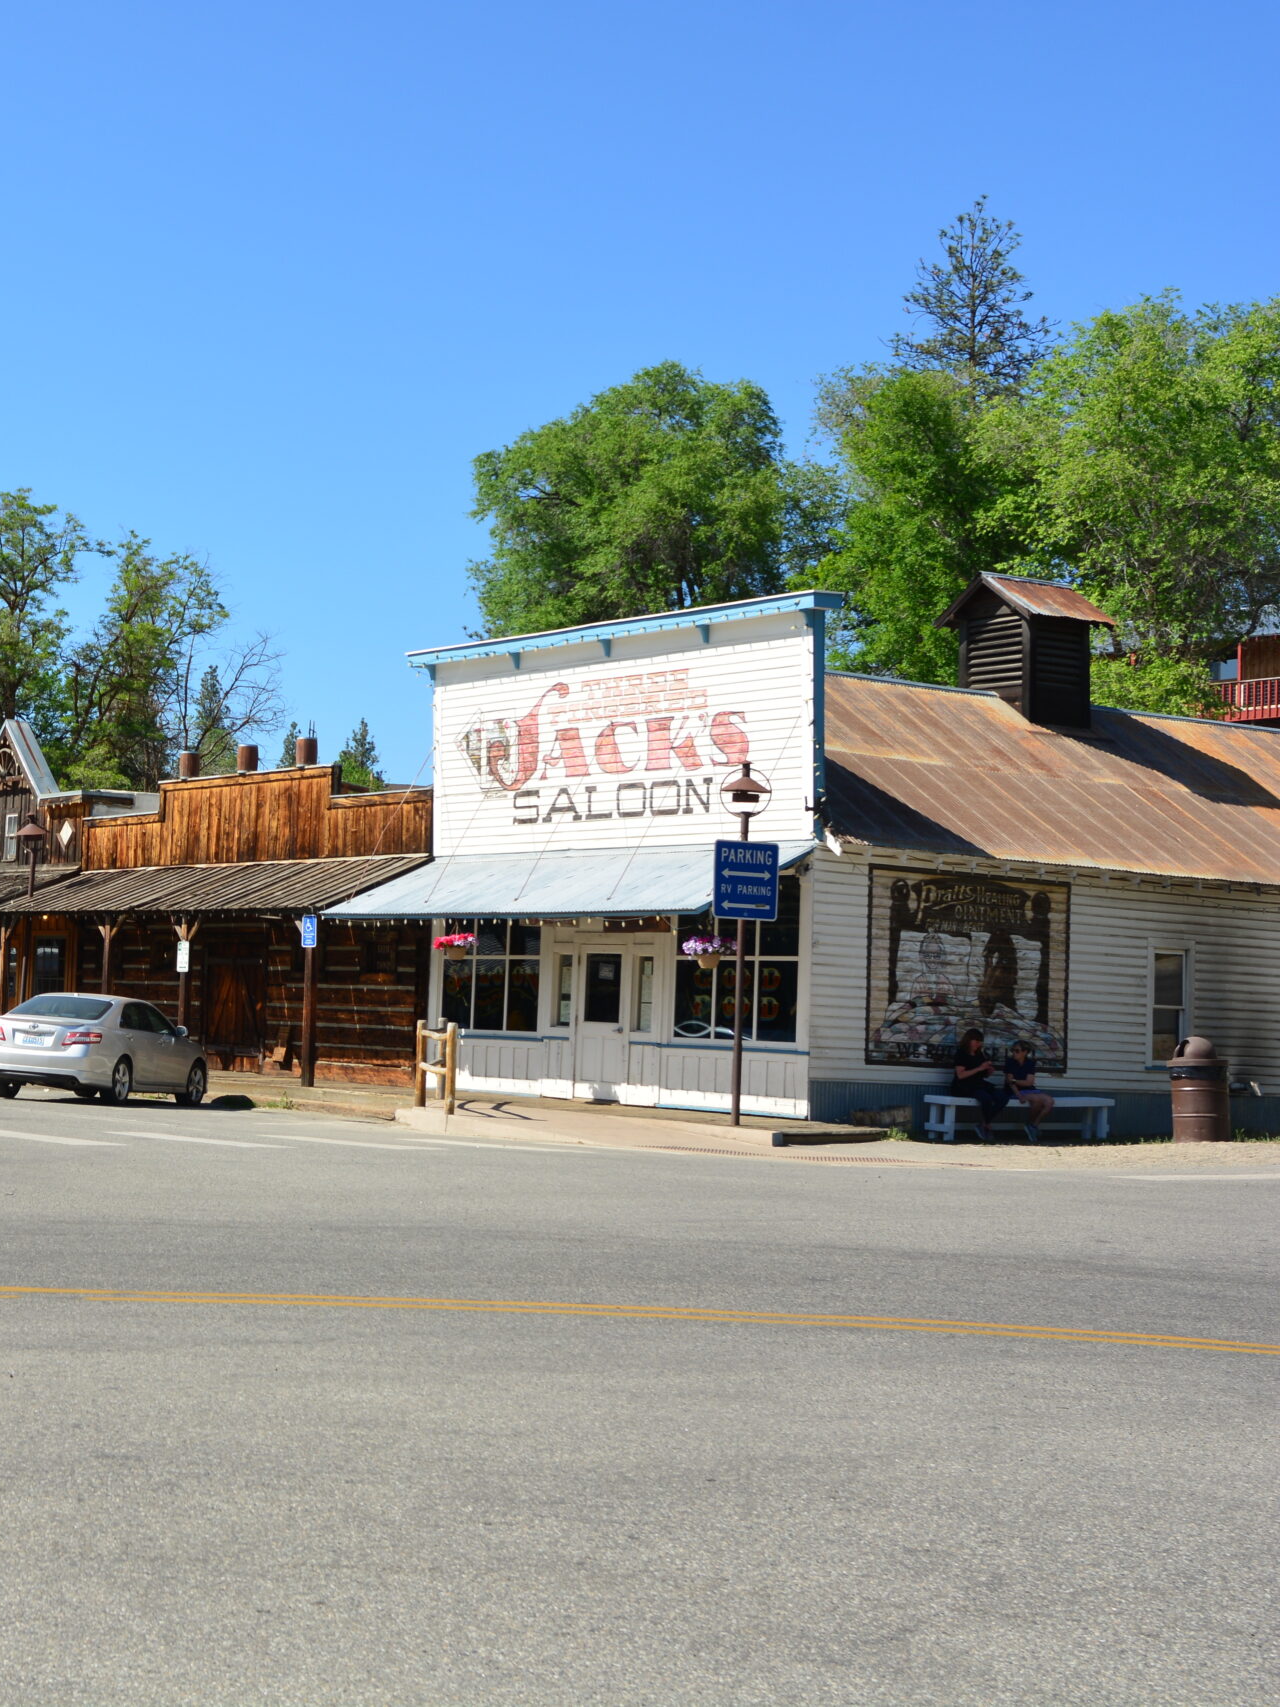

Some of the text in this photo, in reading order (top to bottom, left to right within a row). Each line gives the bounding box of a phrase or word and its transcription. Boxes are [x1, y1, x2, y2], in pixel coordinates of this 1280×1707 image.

[581, 669, 689, 699] THREE
[547, 689, 708, 723] FINGERED
[489, 682, 749, 791] JACK'S
[513, 777, 713, 824] SALOON
[721, 848, 772, 865] PARKING
[721, 883, 772, 896] RV PARKING
[954, 904, 1022, 923] OINTMENT
[693, 967, 782, 991] GOOD
